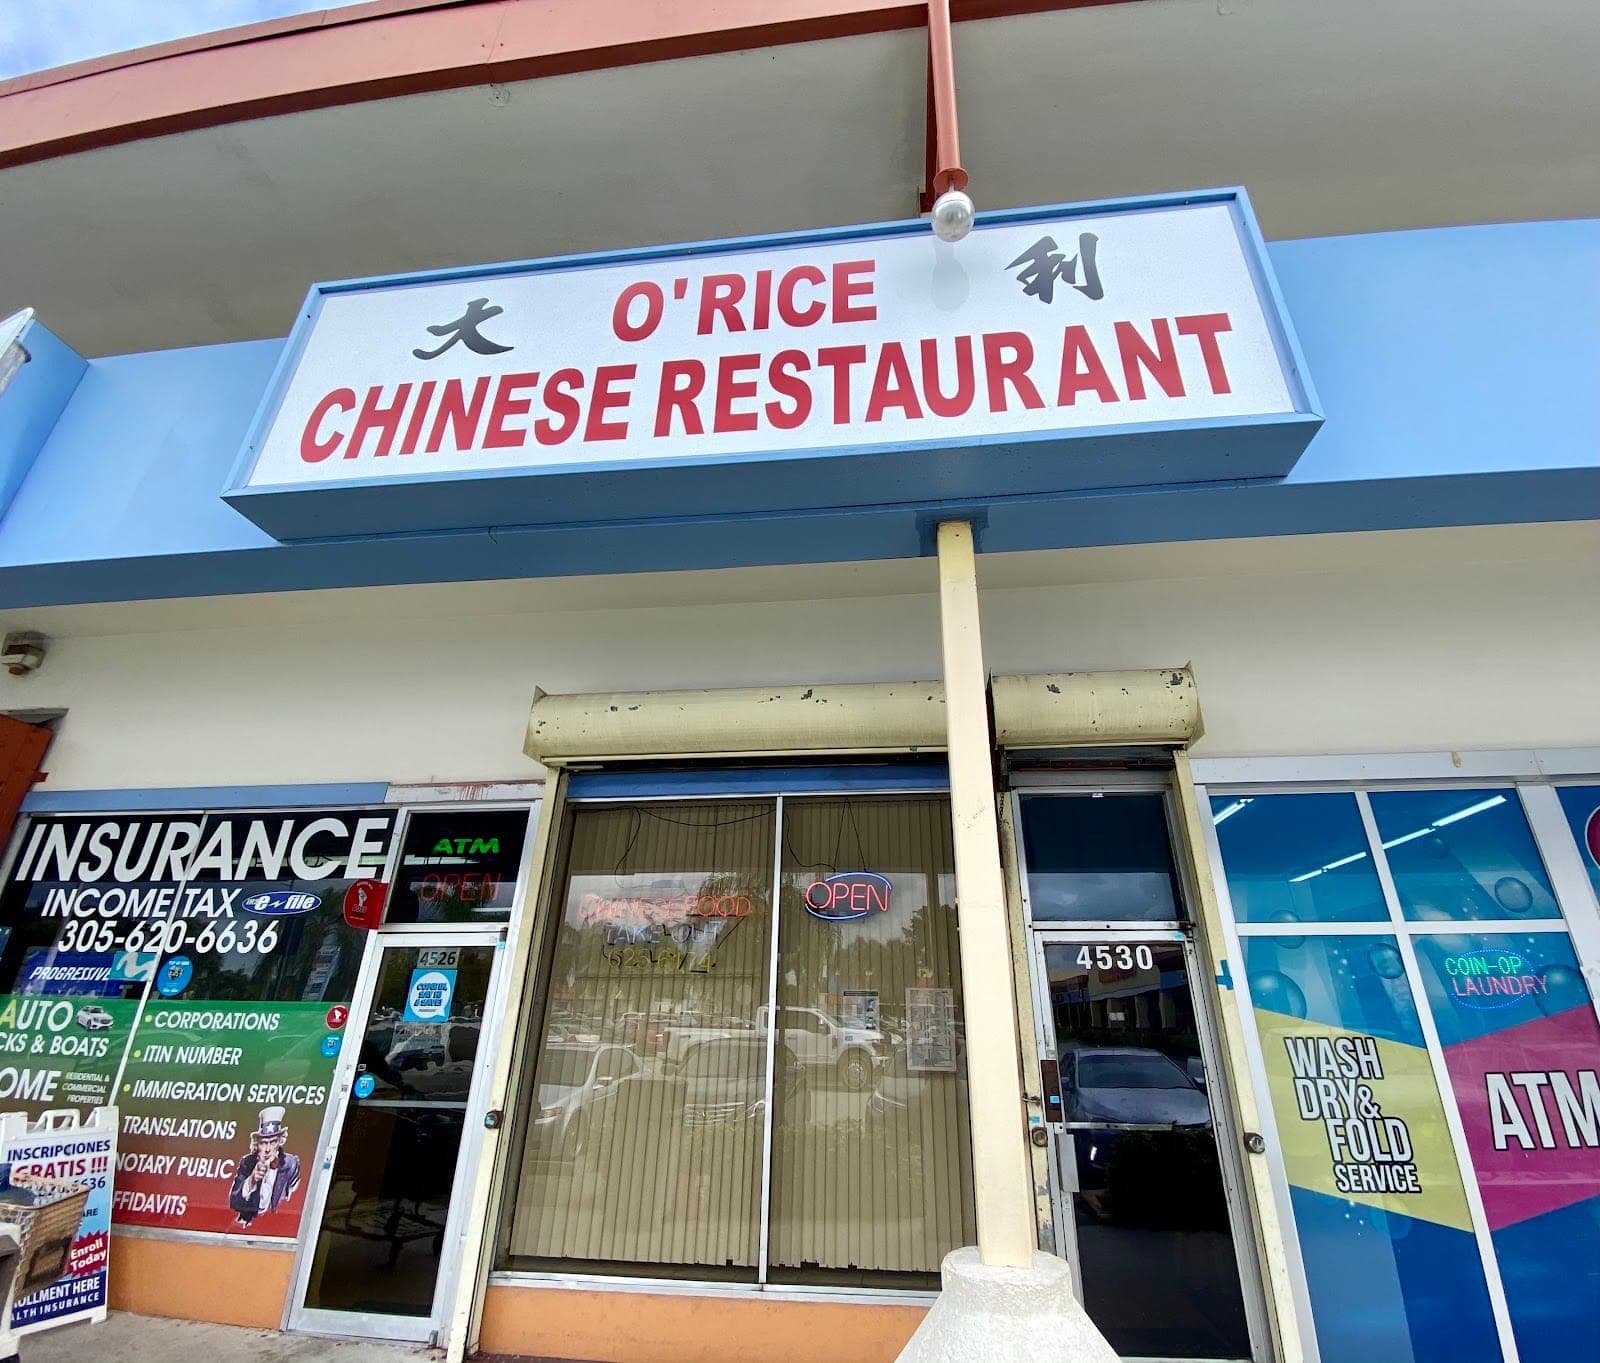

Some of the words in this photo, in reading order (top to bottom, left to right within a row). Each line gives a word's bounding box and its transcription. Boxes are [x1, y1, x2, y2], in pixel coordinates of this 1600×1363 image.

[1004, 232, 1105, 304] 利
[611, 258, 877, 342] O'RICE
[412, 297, 515, 360] 大
[299, 363, 637, 463] CHINESE
[653, 312, 1233, 438] RESTAURANT
[15, 817, 389, 882] INSURANCE
[432, 837, 500, 854] ATM
[421, 873, 503, 902] OPEN
[804, 880, 890, 912] OPEN
[41, 888, 173, 918] INCOME
[182, 888, 243, 918] TAX
[579, 895, 684, 919] CHINESE
[685, 895, 752, 917] FOOD
[58, 919, 279, 954] 305-620-6636
[419, 951, 457, 966] 4526
[1076, 945, 1153, 970] 4530
[1444, 956, 1522, 975] COIN-OP
[29, 966, 111, 981] PROGRESSIVE
[1451, 975, 1548, 996] LAUNDRY
[0, 999, 74, 1031] AUTO
[154, 1011, 281, 1031] CORPORATIONS
[30, 1034, 45, 1053] &
[49, 1035, 110, 1058] BOATS
[143, 1045, 173, 1063] ITIN
[175, 1047, 243, 1065] NUMBER
[1284, 1037, 1384, 1079] WASH
[0, 1066, 62, 1101] OME
[62, 1083, 106, 1093] COMMERCIAL
[132, 1079, 245, 1102] IMMIGRATION
[247, 1084, 325, 1105] SERVICES
[1485, 1069, 1600, 1152] ATM
[122, 1115, 237, 1140] TRANSLATIONS
[1324, 1117, 1414, 1163] FOLD
[7, 1140, 111, 1162] INSCRIPCIONES
[116, 1152, 176, 1175] NOTARY
[177, 1156, 236, 1179] PUBLIC
[1333, 1162, 1423, 1193] SERVICE
[112, 1190, 188, 1215] FFIDAVITS
[70, 1250, 107, 1271] Today
[71, 1238, 103, 1260] Enroll
[14, 1284, 71, 1308] OLLMENT
[72, 1277, 100, 1294] HERE
[12, 1307, 37, 1321] LTH
[40, 1292, 100, 1314] INSURANCE
